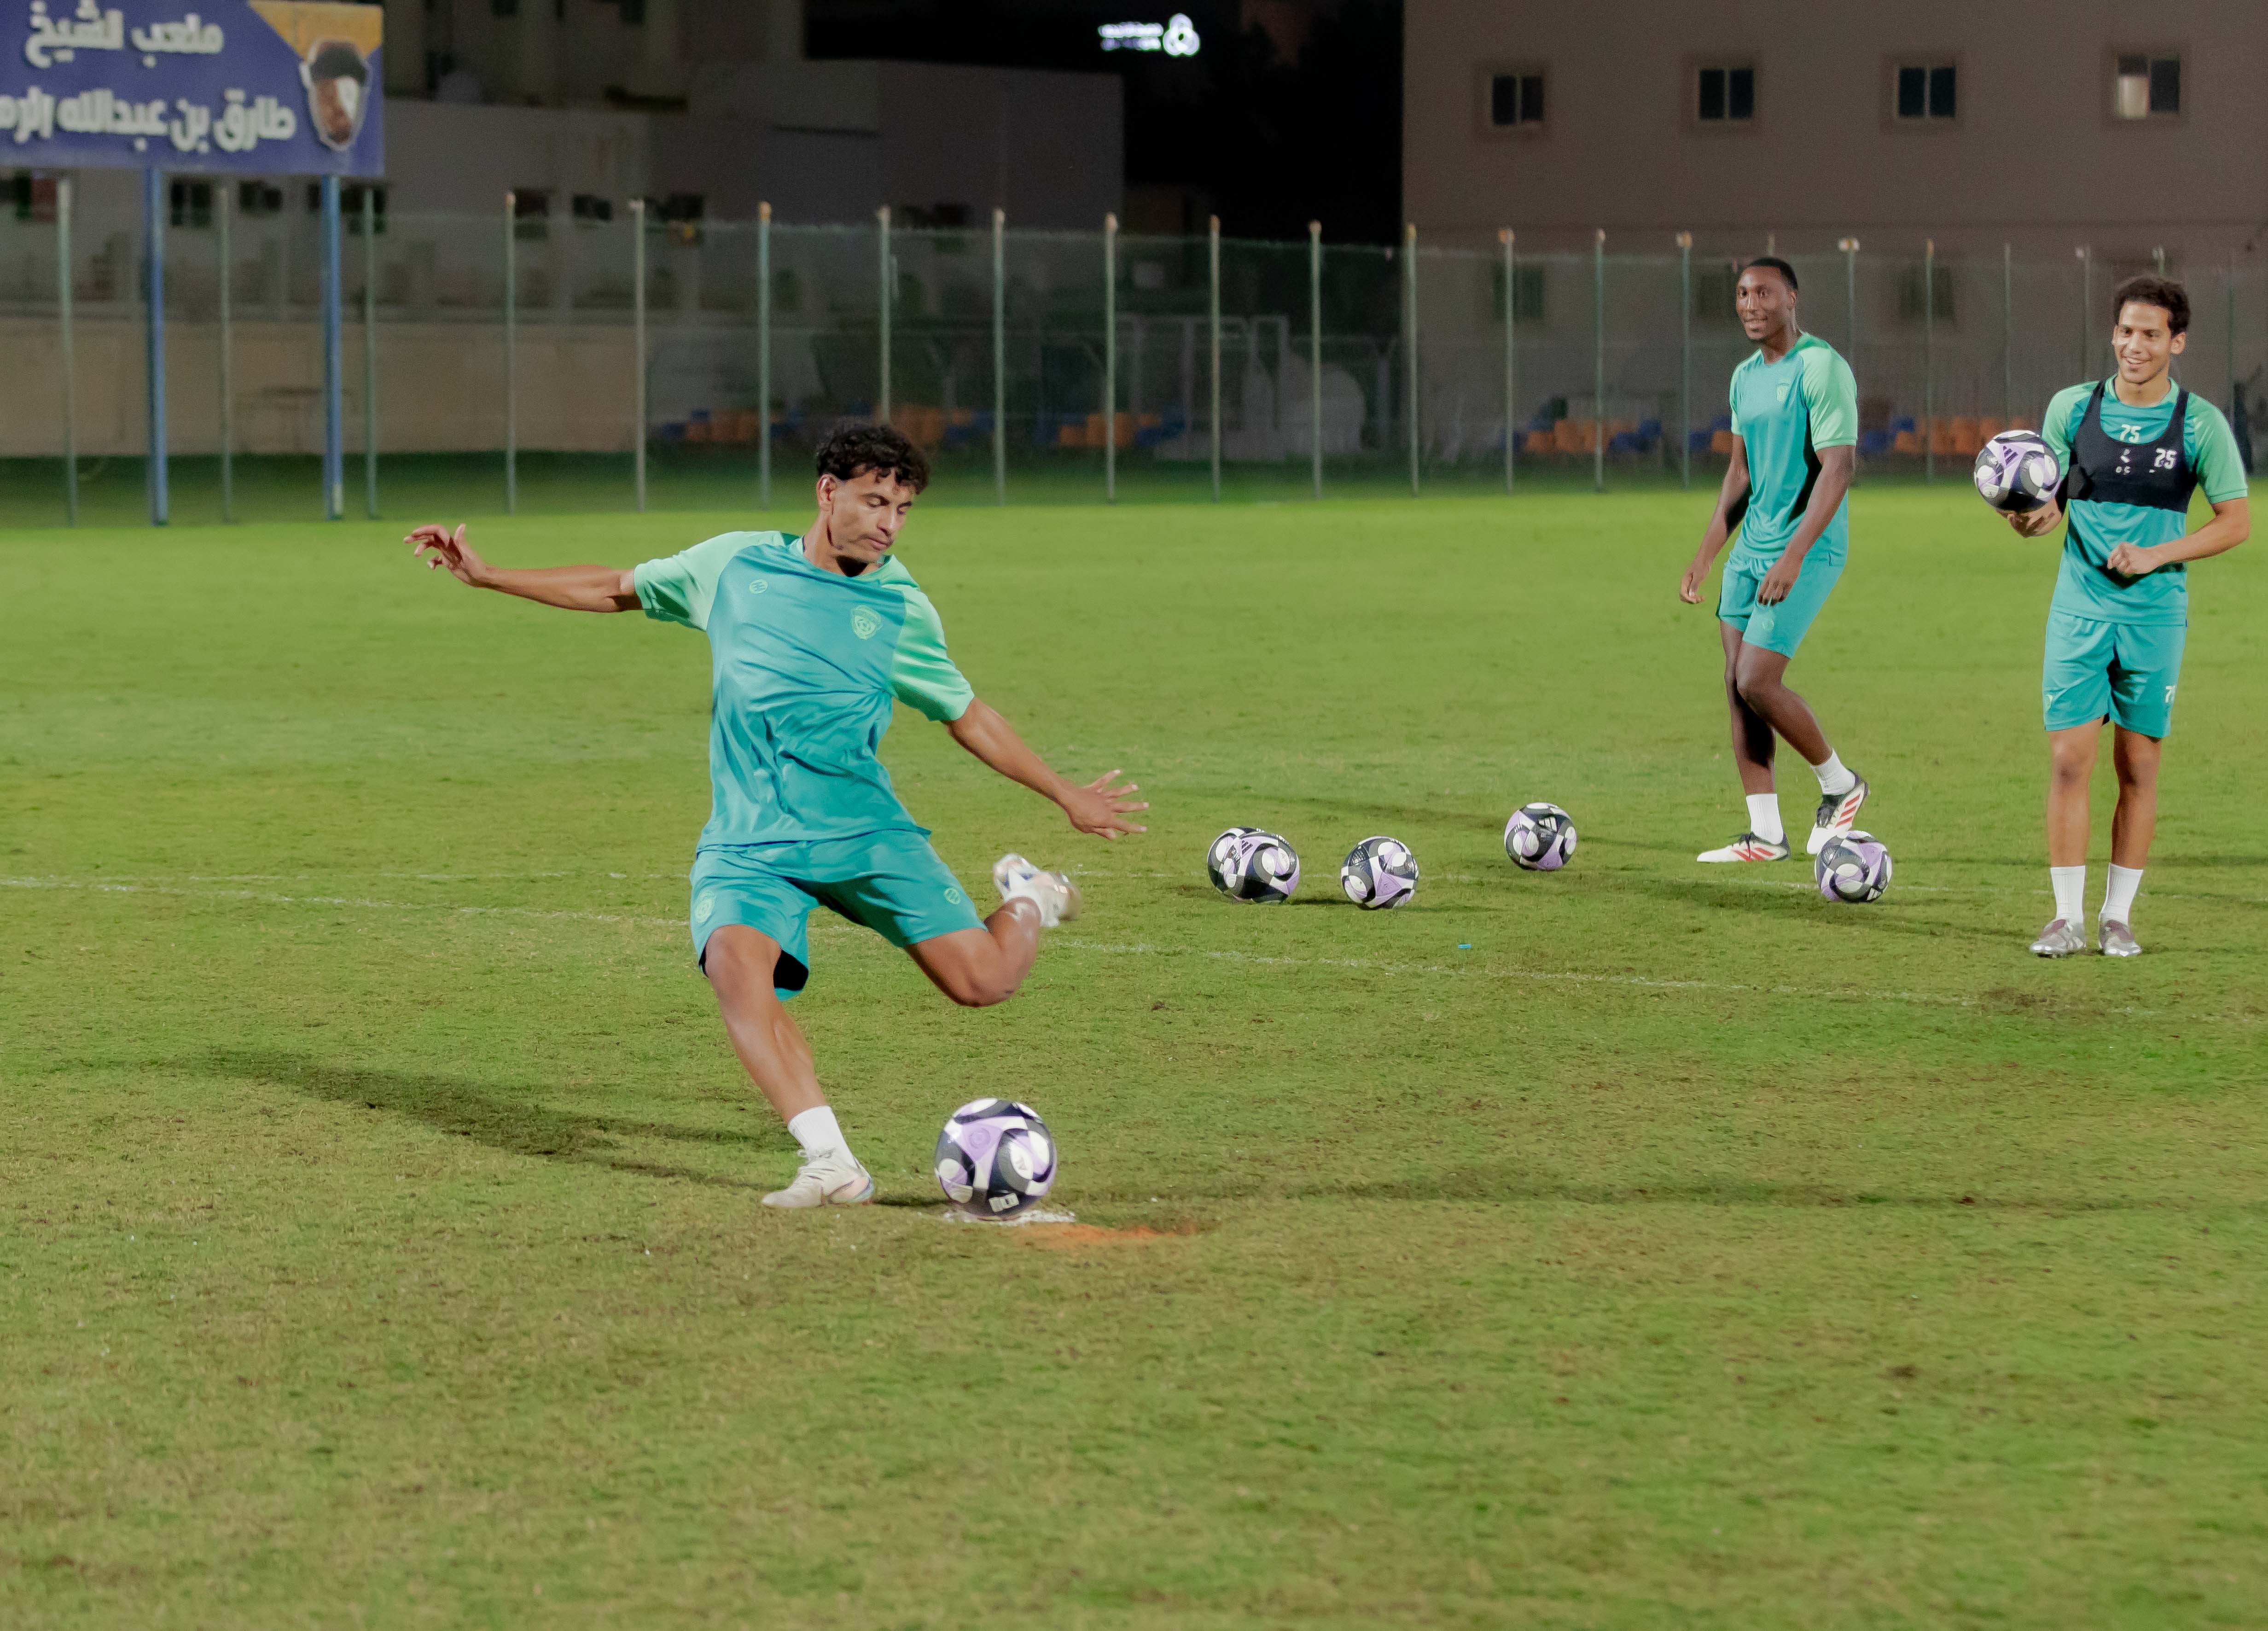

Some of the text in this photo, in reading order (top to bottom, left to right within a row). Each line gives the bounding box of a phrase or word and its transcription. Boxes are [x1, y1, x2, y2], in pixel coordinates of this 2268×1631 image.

[25, 0, 224, 68] ملعب الشيخ
[57, 88, 169, 151] عبدالله
[170, 98, 210, 153] بن
[213, 88, 297, 152] طارق
[2120, 424, 2141, 443] 75
[2154, 448, 2177, 470] 75
